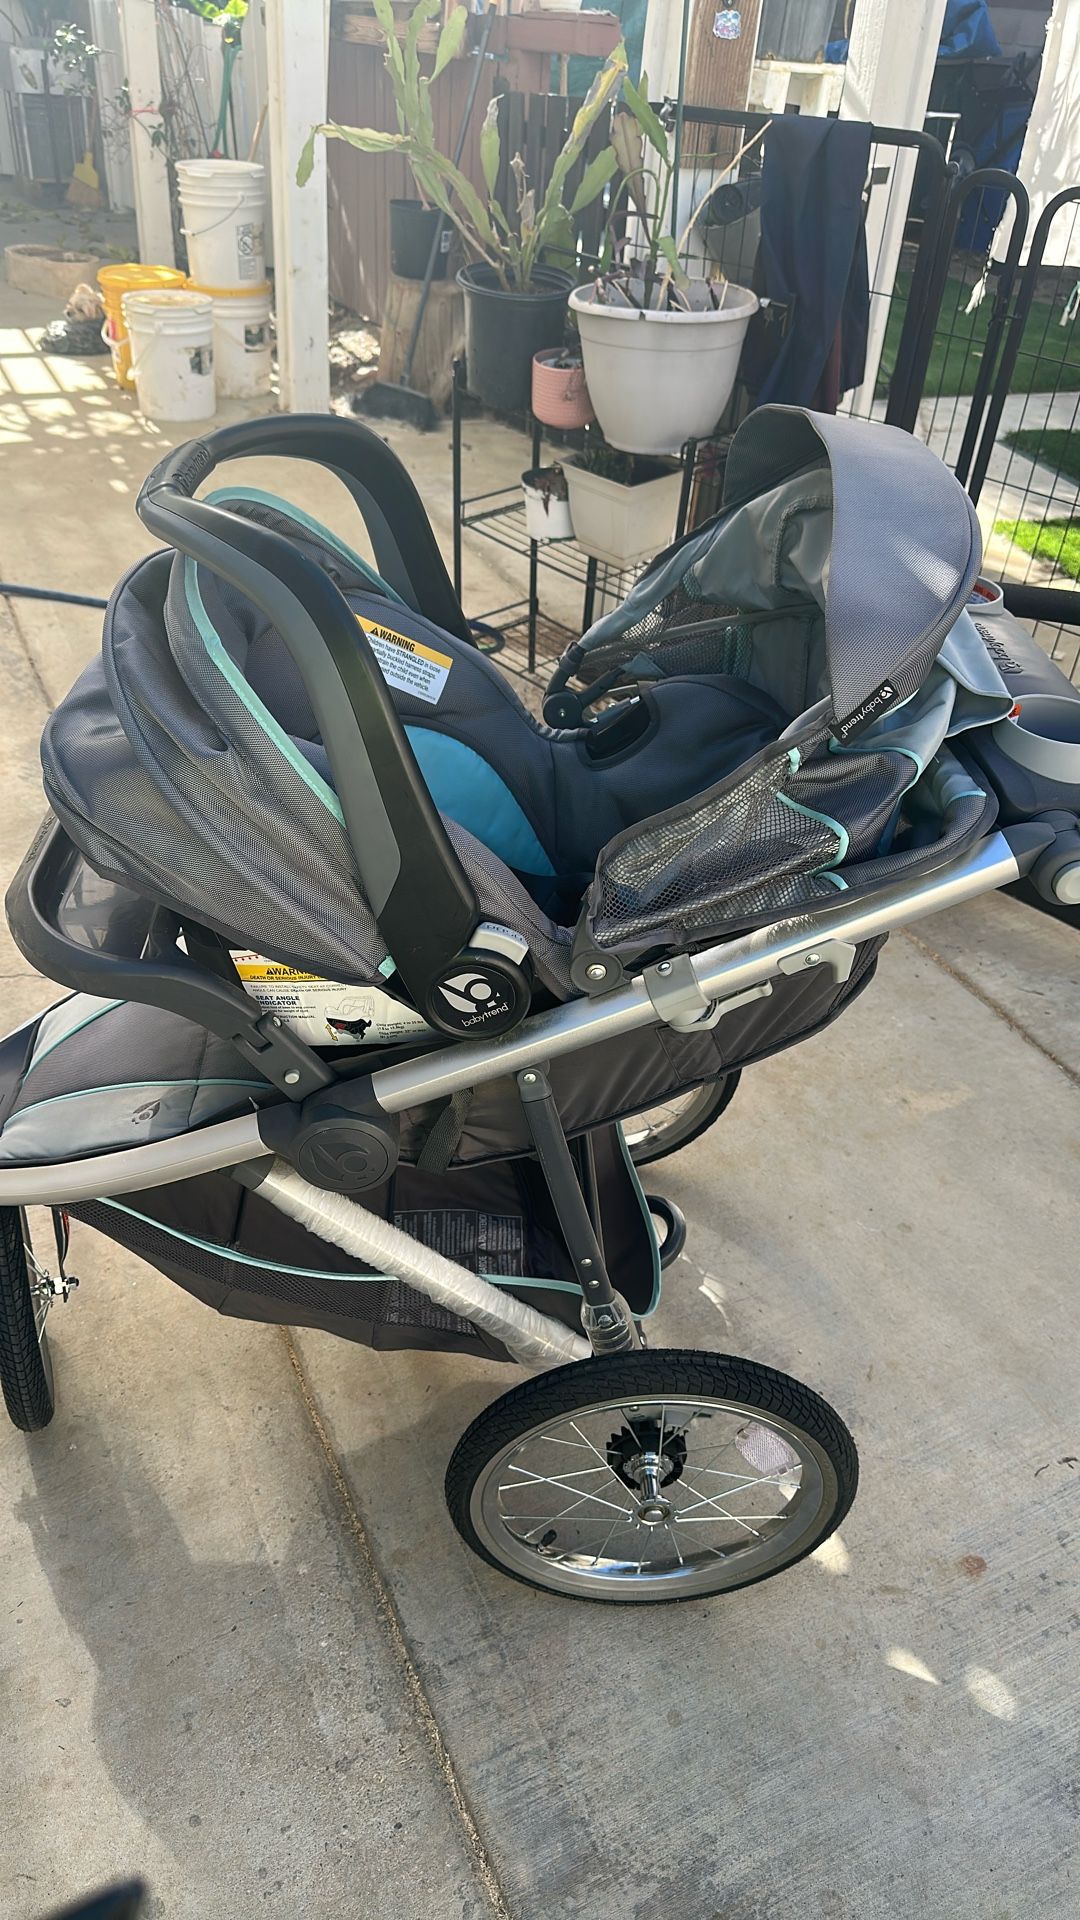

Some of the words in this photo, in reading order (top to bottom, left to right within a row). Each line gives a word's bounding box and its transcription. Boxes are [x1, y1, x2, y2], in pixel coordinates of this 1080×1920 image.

[379, 629, 416, 652] WARNING
[396, 649, 425, 666] STRANGLED
[461, 1002, 509, 1027] babytrend
